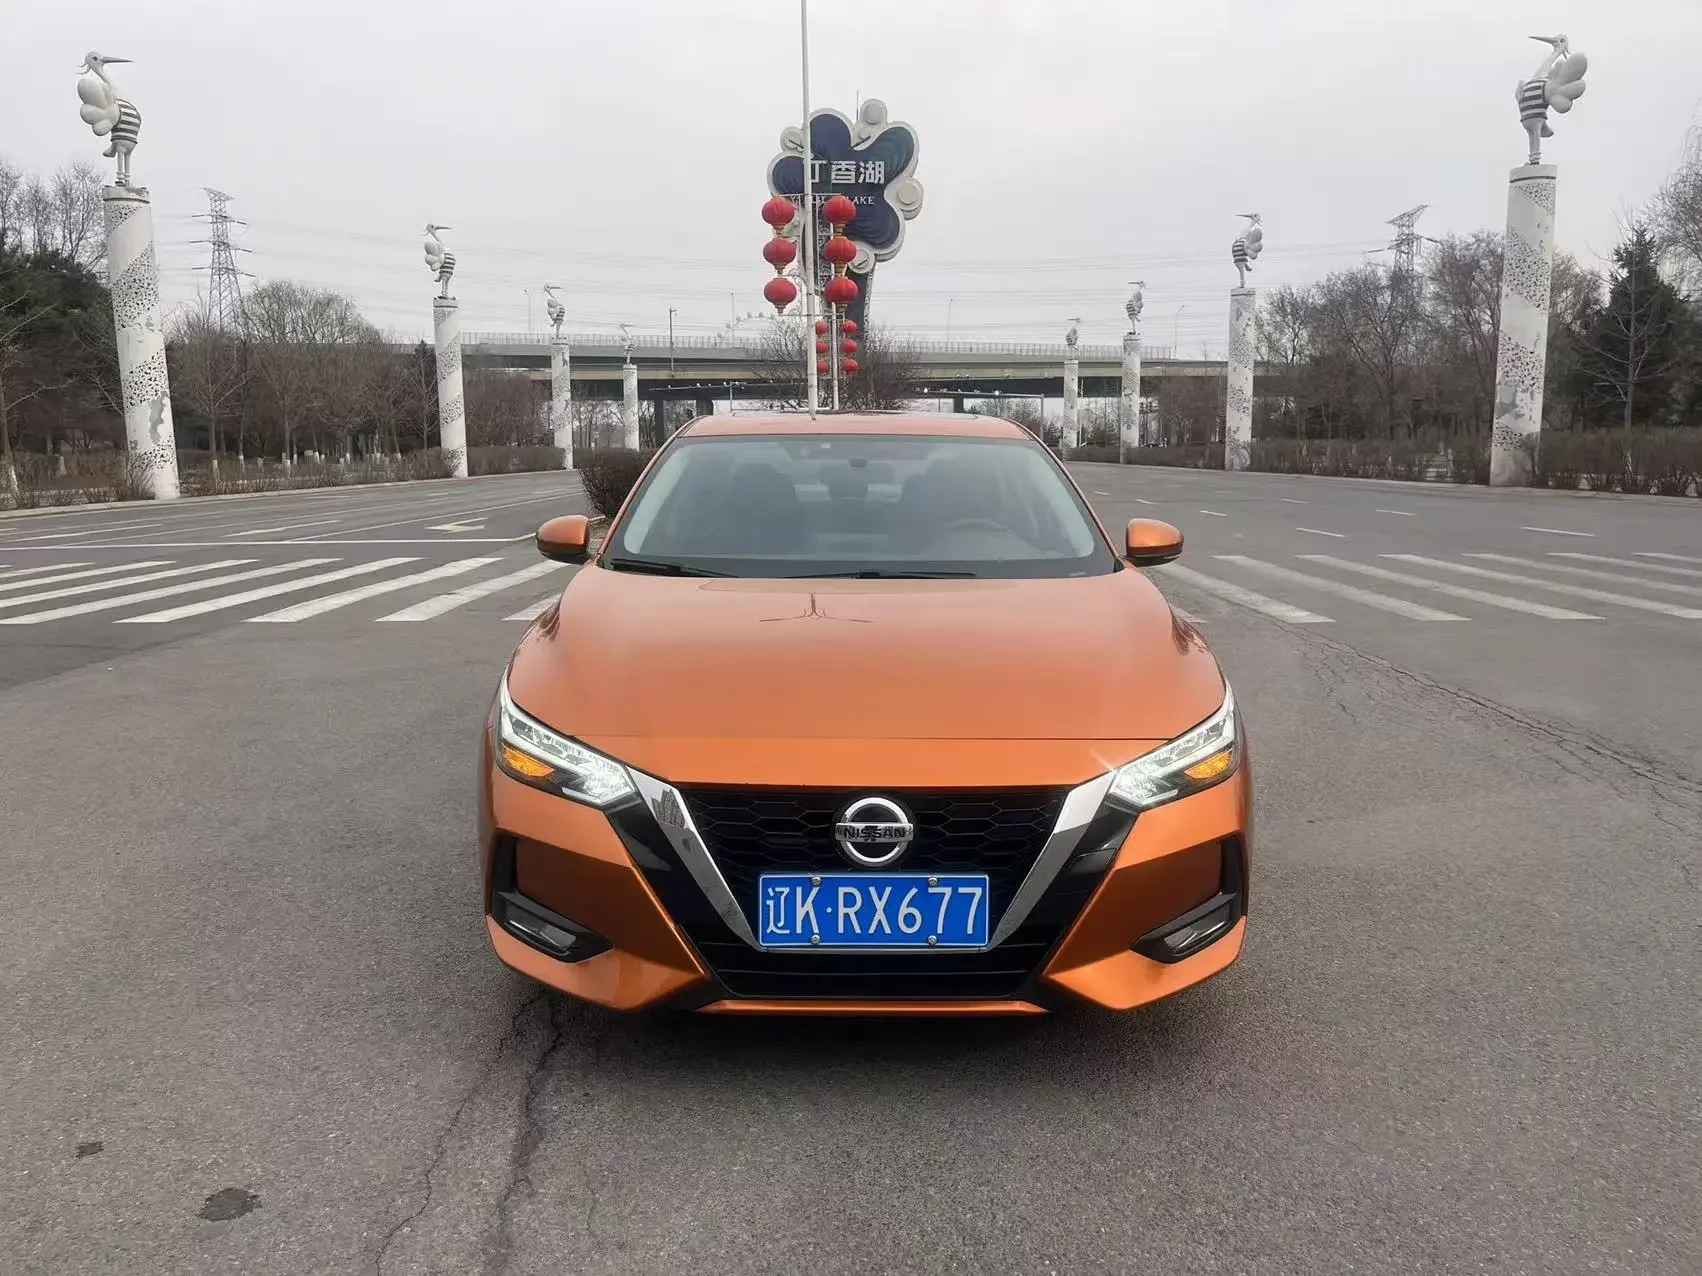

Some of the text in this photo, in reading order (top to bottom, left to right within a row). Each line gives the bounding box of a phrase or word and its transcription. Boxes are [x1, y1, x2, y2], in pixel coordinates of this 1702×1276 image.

[803, 160, 885, 185] 丁香湖
[843, 826, 906, 839] NISSAN
